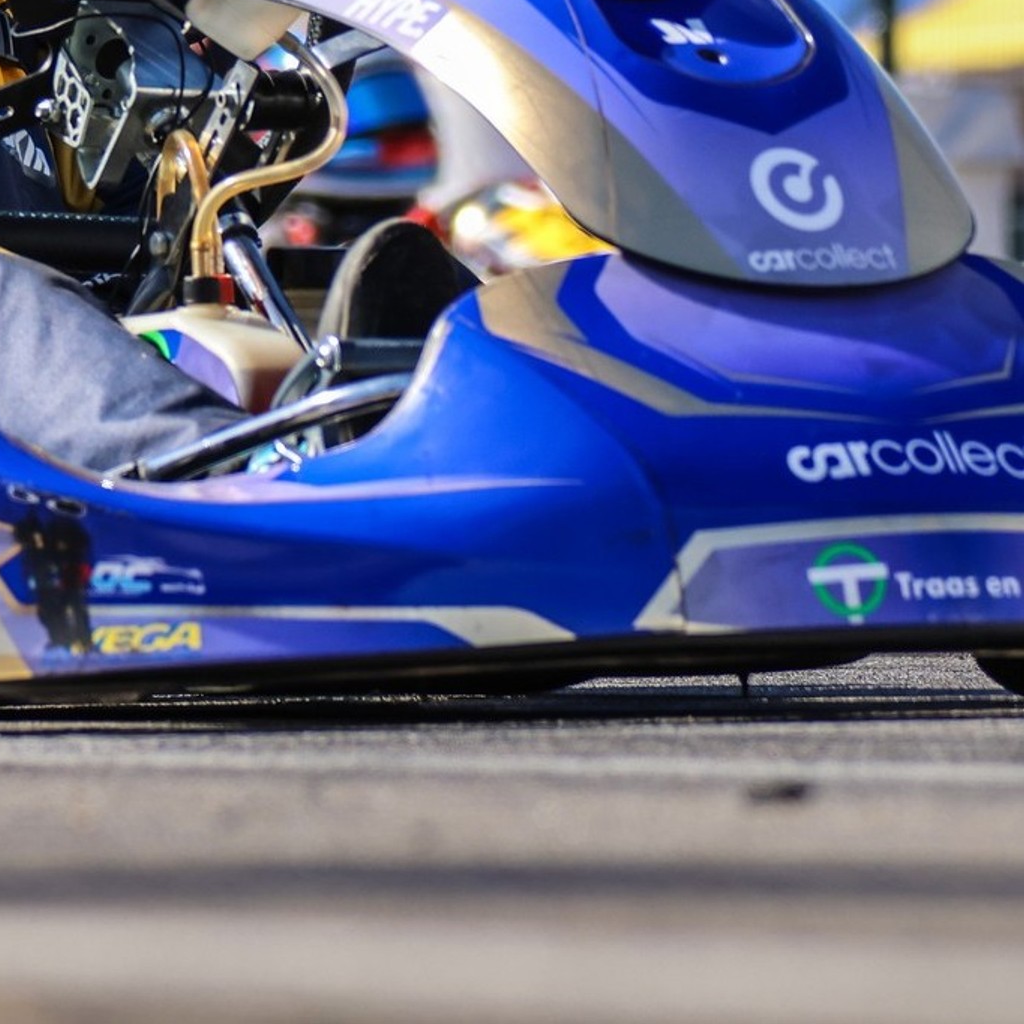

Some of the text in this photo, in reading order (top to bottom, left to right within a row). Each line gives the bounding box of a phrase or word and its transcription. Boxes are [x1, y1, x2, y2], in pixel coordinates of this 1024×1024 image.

[747, 243, 897, 273] carcollect
[786, 431, 1024, 483] carcollec
[893, 572, 1022, 600] Traas en
